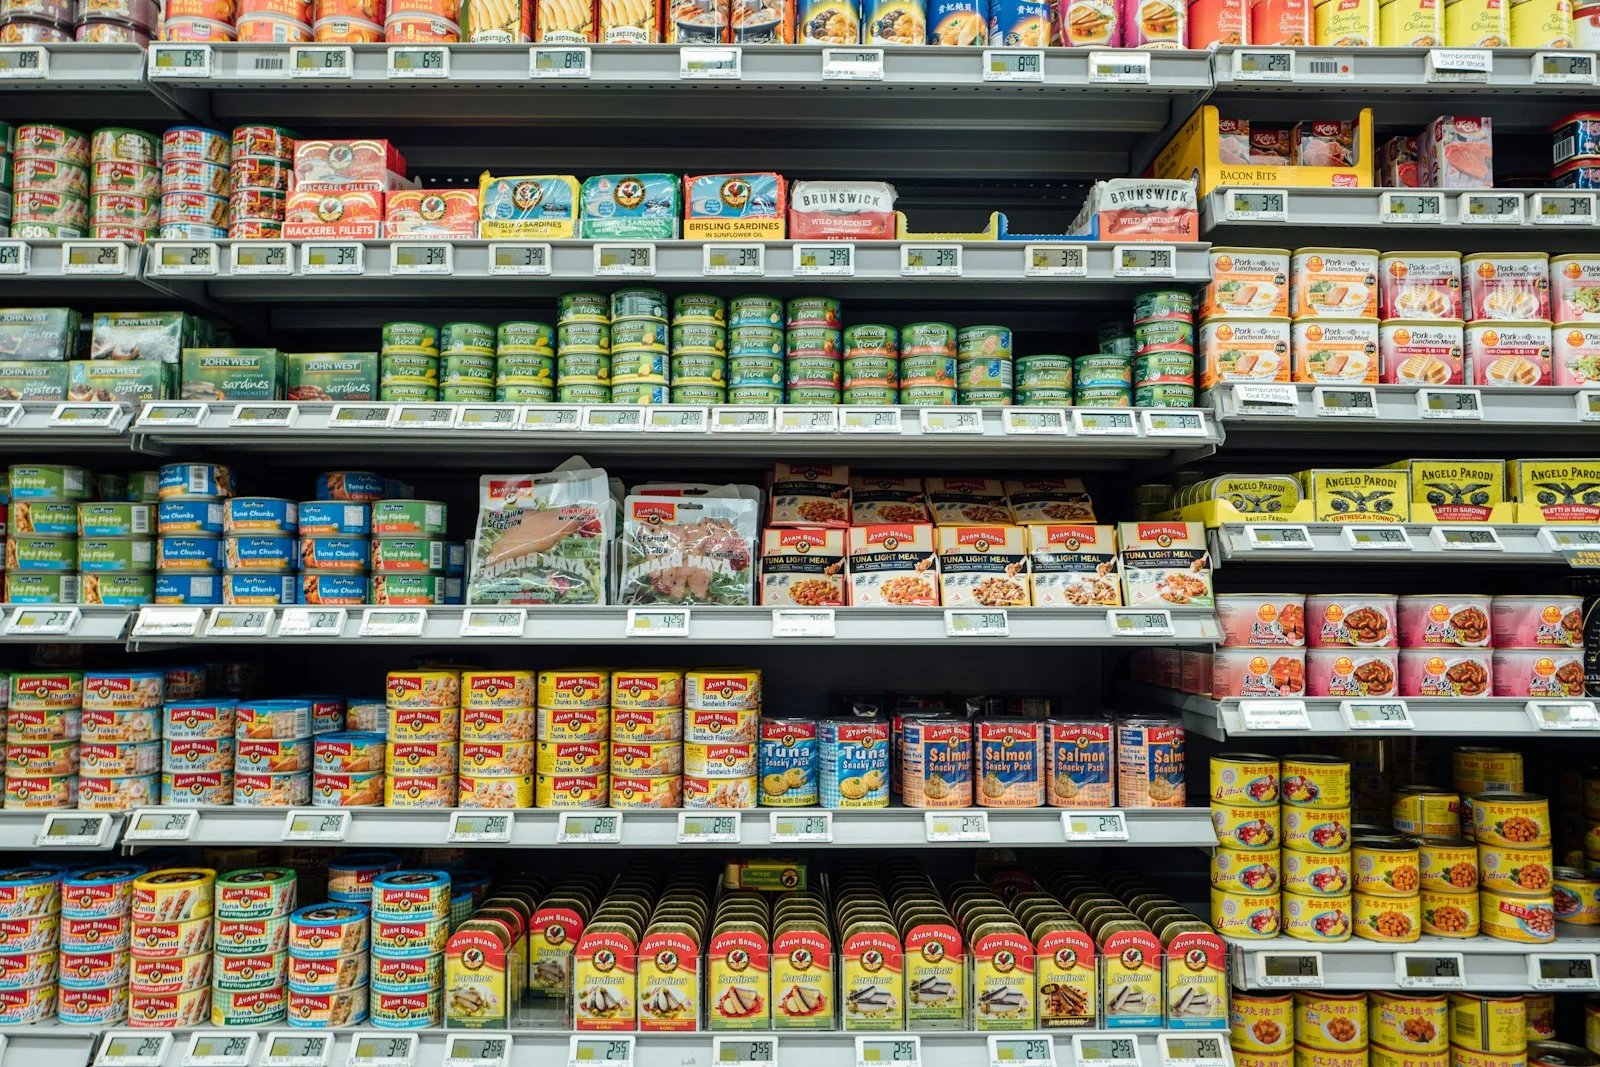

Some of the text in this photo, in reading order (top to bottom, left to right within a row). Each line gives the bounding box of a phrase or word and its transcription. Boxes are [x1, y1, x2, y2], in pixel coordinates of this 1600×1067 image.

[1332, 14, 1361, 24] Boneless
[1324, 25, 1350, 36] Chicken
[555, 34, 586, 43] asparagus
[1440, 52, 1485, 60] Temporarily
[1315, 124, 1339, 136] Kelly's
[300, 183, 379, 192] MACKEREL FILLETS
[803, 193, 880, 206] BRUNSWICK
[1110, 188, 1188, 204] BRUNSWICK
[734, 222, 780, 230] SARDINES
[833, 219, 872, 227] SARDINES
[286, 226, 373, 236] MACKEREL FILLETS
[1147, 336, 1168, 344] tuna
[202, 358, 229, 366] JOHN
[307, 362, 332, 370] JOHN
[859, 370, 880, 378] tuna
[222, 378, 269, 389] sardines
[326, 382, 370, 393] sardines
[115, 384, 153, 396] oysters
[1244, 386, 1289, 395] Temporarily
[1422, 468, 1493, 481] ANGELO PARODI
[1326, 475, 1397, 488] ANGELO PARODI
[488, 510, 524, 519] PREMIUM
[1332, 514, 1366, 522] VENTRESCA
[1372, 514, 1394, 522] TONNO
[487, 519, 522, 530] SELECTION
[869, 531, 912, 541] AYAM BRAND
[960, 532, 1004, 543] AYAM BRAND
[1141, 527, 1186, 538] AYAM BRAND
[38, 550, 62, 558] Flakes
[874, 554, 897, 562] LIGHT
[20, 679, 67, 690] AYAM BRAND
[473, 678, 513, 688] AYAM BRAND
[767, 726, 809, 737] AYAM BRAND
[987, 728, 1031, 738] AYAM BRAND
[709, 748, 748, 757] AYAM BRAND
[765, 744, 809, 757] Tuna
[986, 747, 1032, 761] Salmon
[765, 758, 809, 768] Snacky Pack
[986, 762, 1032, 773] Snacky Pack
[225, 888, 268, 899] AYAM BRAND
[451, 937, 497, 949] AYAM BRAND
[850, 939, 896, 951] AYAM BRAND
[1110, 937, 1155, 949] AYAM BRAND
[453, 973, 492, 983] Sardines
[852, 976, 892, 984] Sardines
[1113, 974, 1152, 982] Sardines
[1305, 1001, 1358, 1014] 红烧猪肉
